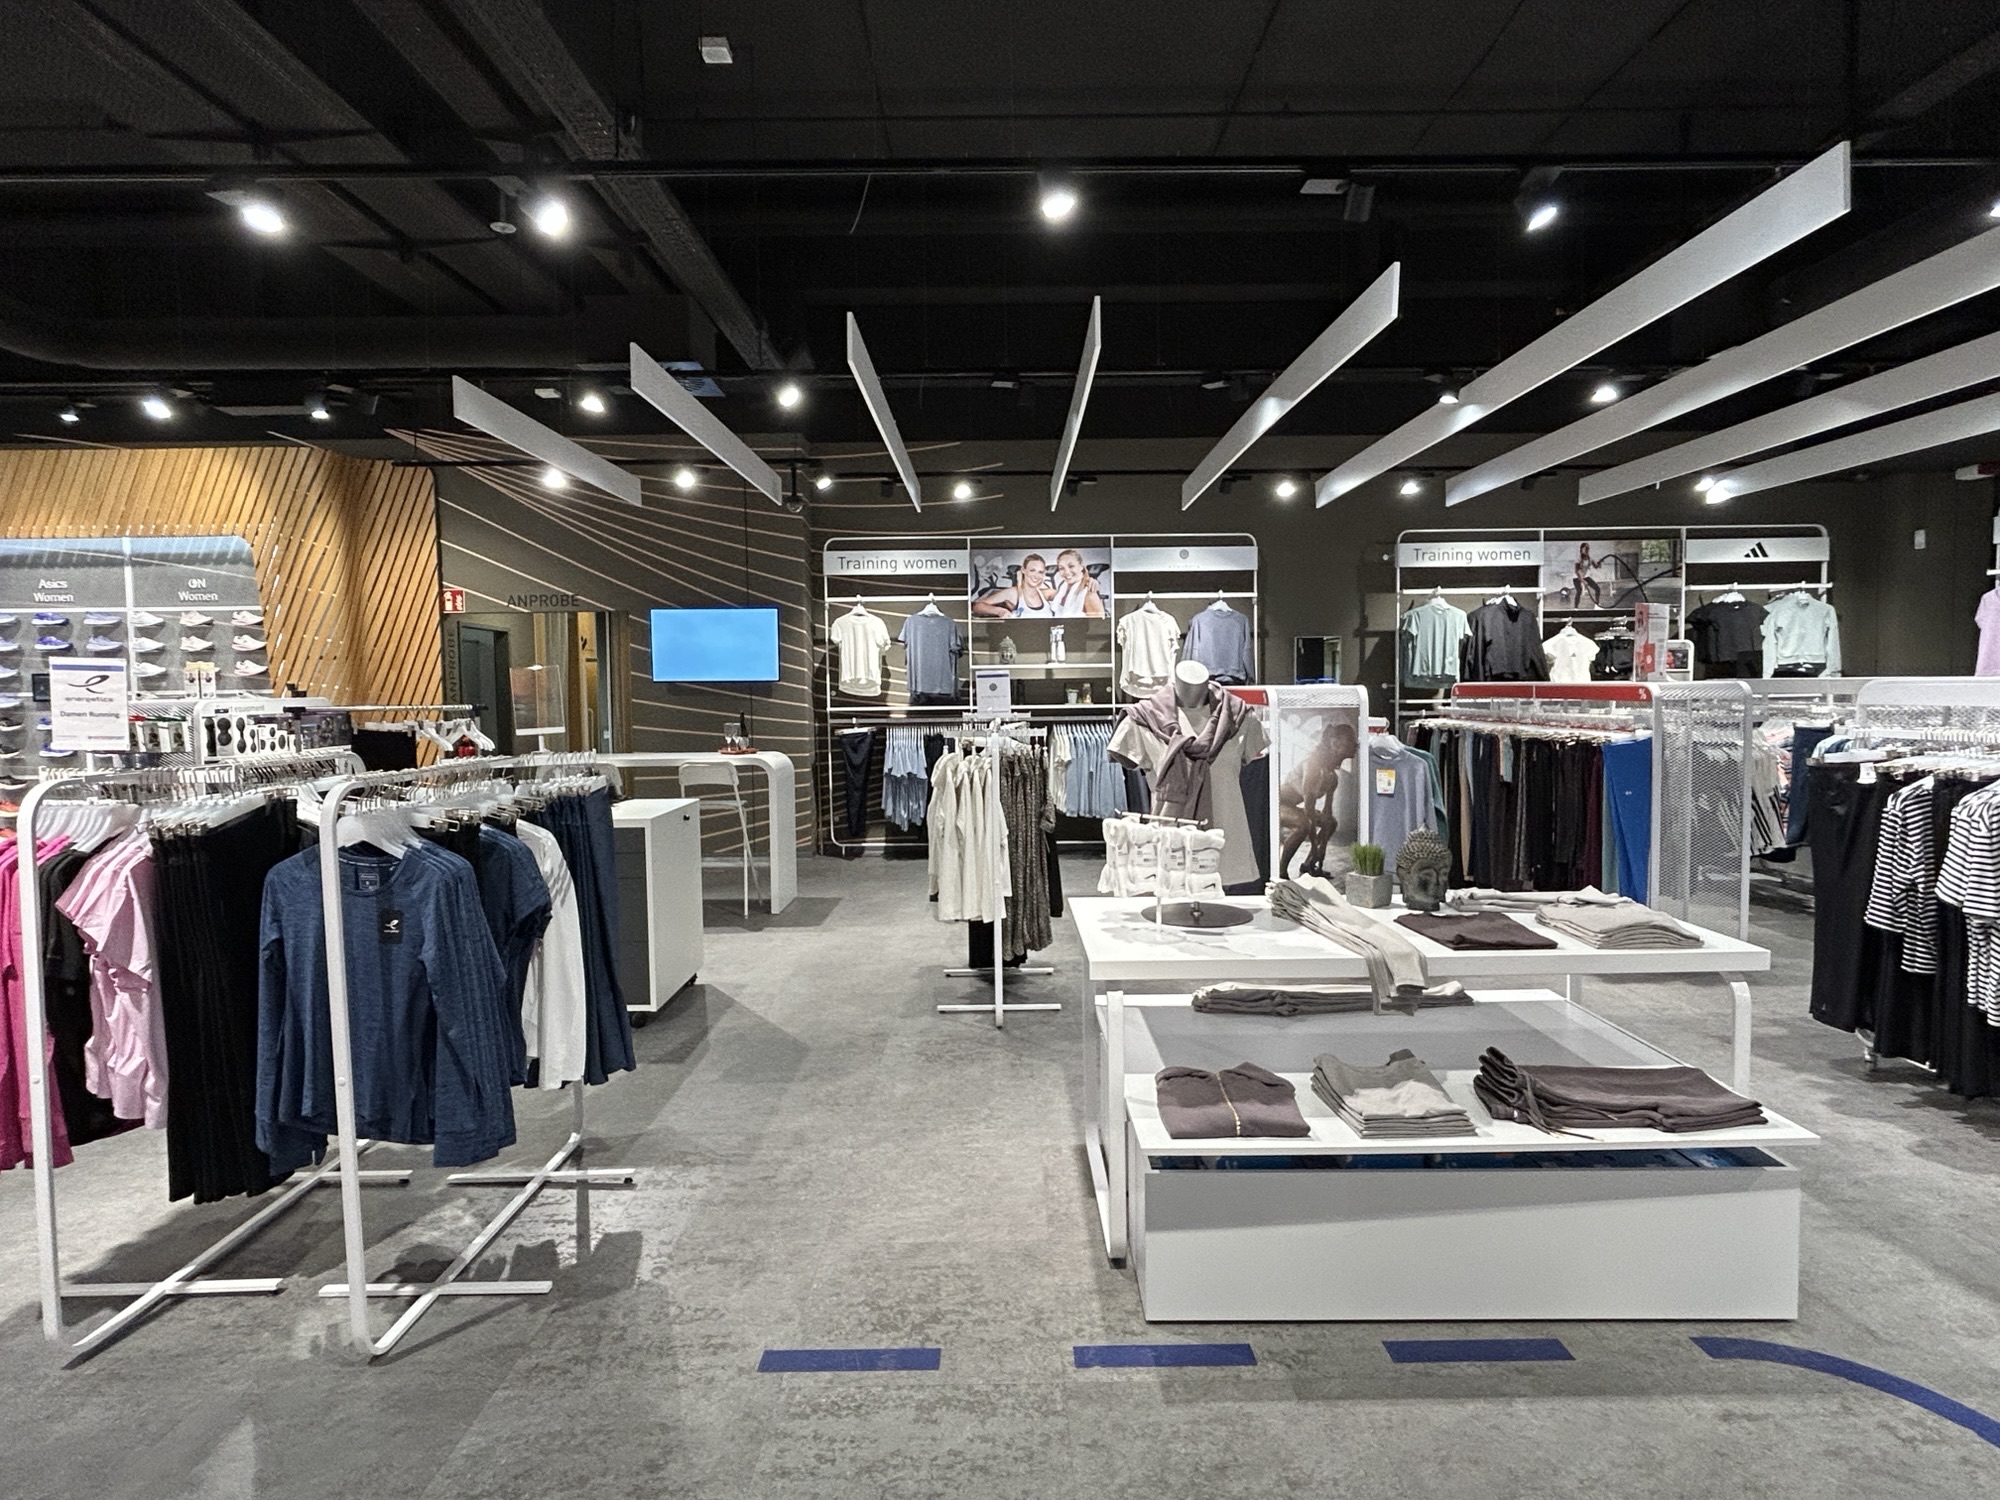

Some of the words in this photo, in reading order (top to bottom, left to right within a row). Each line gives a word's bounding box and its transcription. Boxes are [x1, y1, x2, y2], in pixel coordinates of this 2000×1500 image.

[1413, 548, 1473, 564] Training
[1477, 550, 1531, 561] women
[837, 556, 898, 572] Training
[903, 558, 957, 569] women
[38, 578, 68, 589] Asics
[33, 592, 74, 602] Women
[178, 591, 218, 602] Women
[507, 594, 580, 607] ANPROBE
